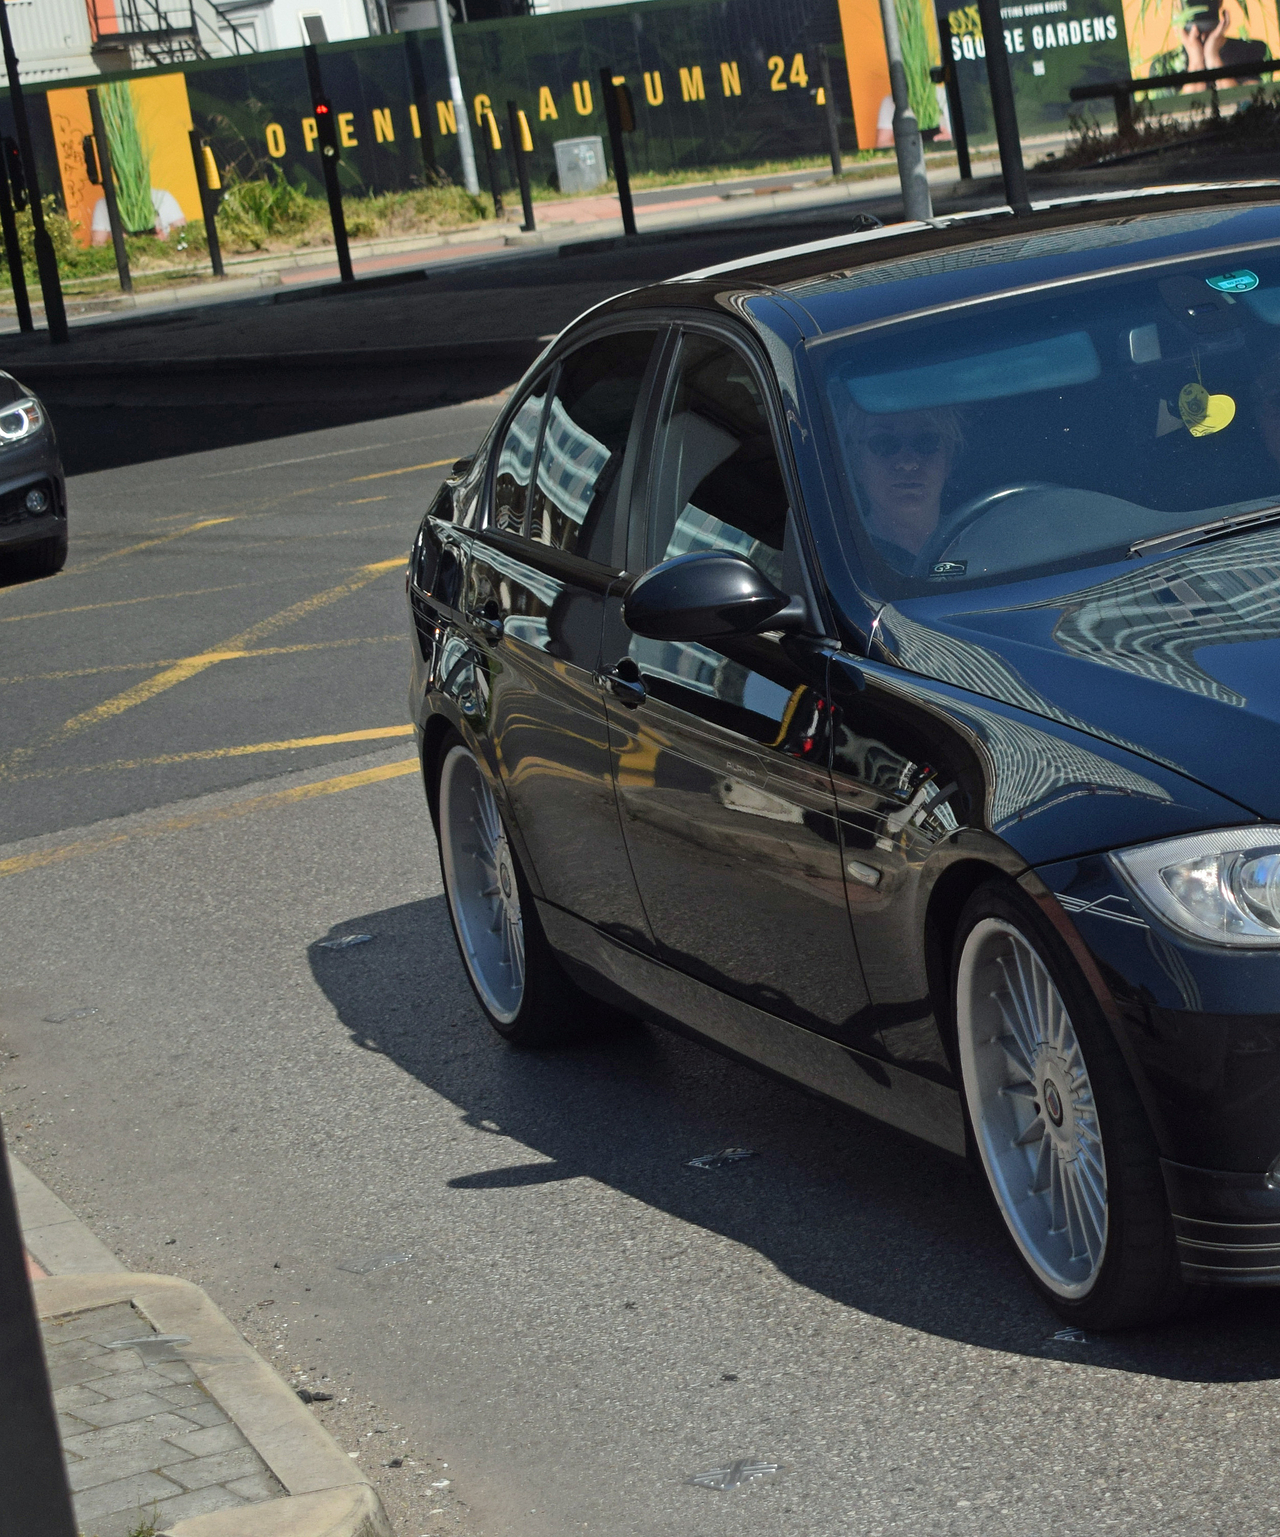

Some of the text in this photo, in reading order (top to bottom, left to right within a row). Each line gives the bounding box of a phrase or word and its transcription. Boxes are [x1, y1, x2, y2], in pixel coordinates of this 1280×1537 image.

[951, 15, 1118, 61] SQURE GARDENS
[539, 61, 742, 121] AUUMN
[768, 53, 809, 91] 24
